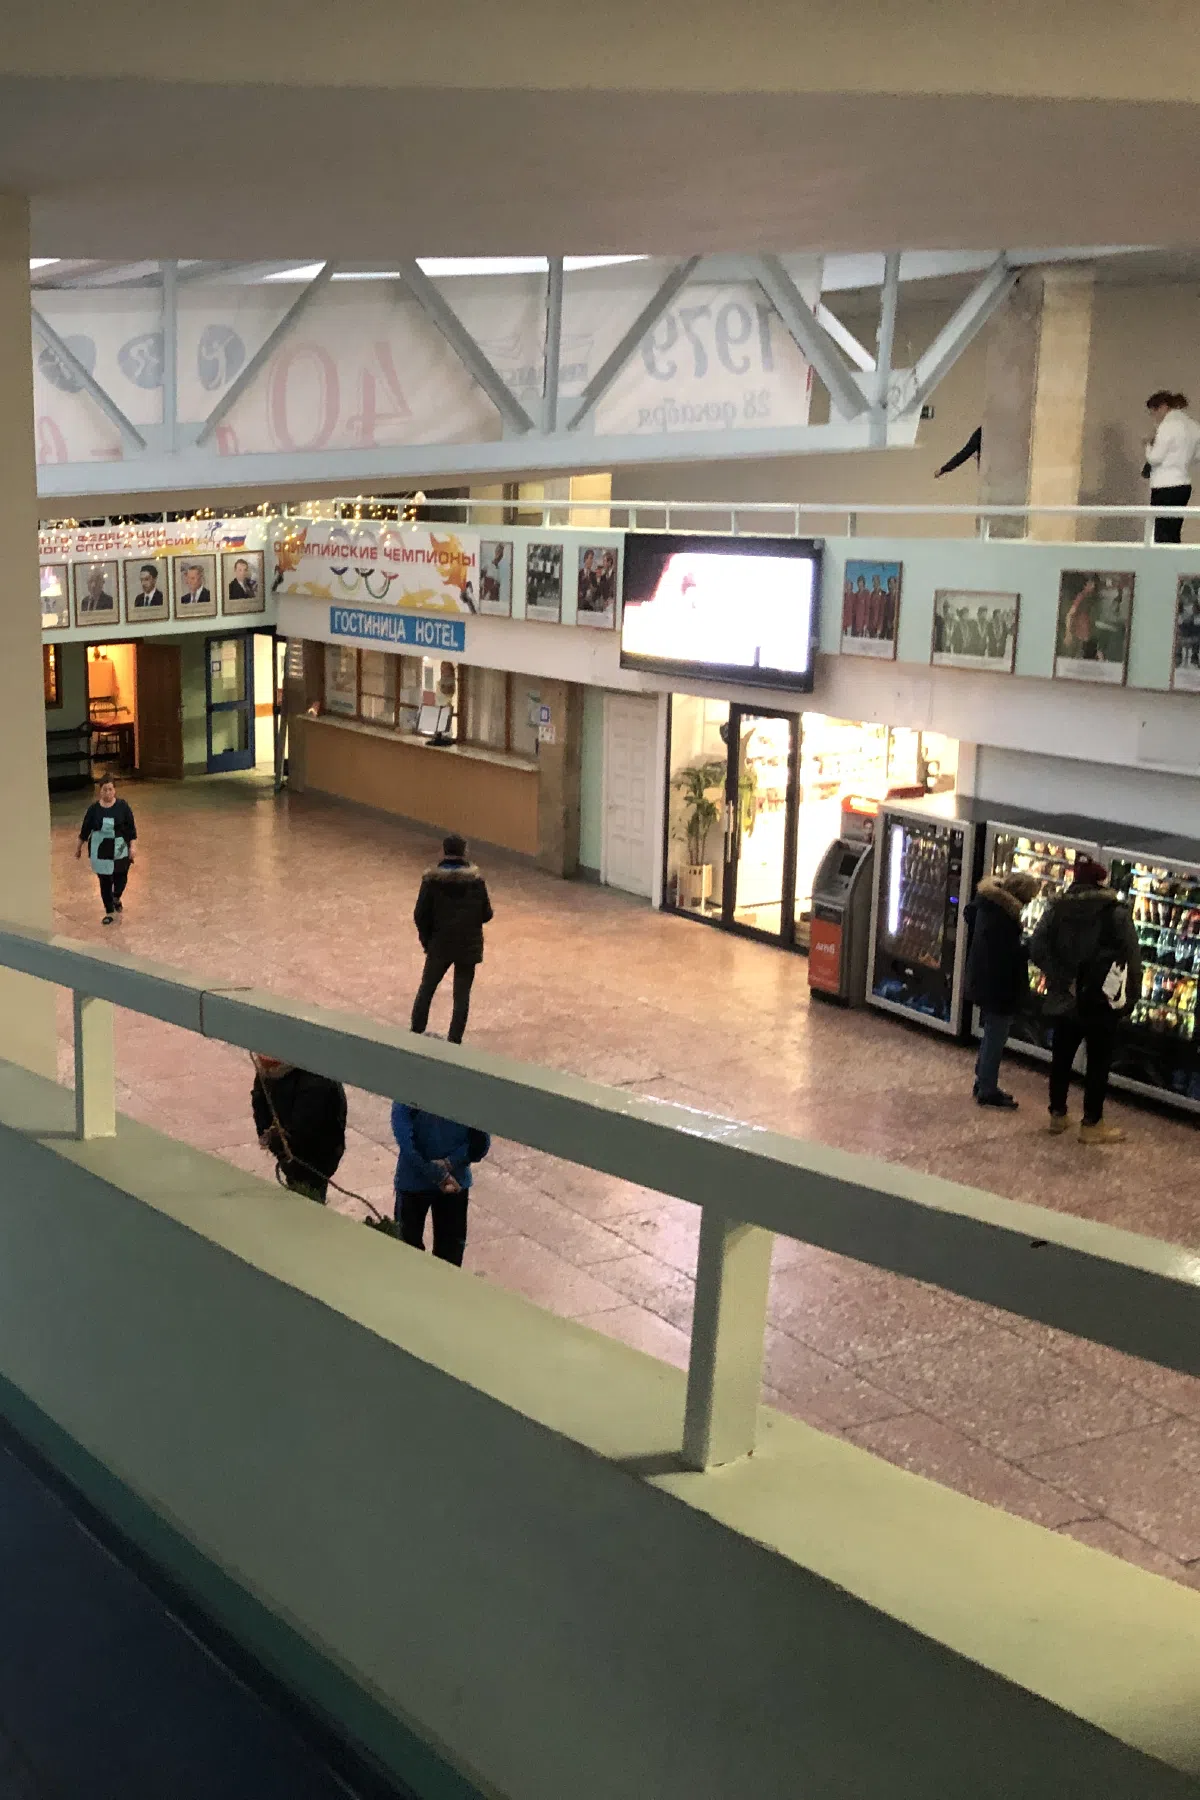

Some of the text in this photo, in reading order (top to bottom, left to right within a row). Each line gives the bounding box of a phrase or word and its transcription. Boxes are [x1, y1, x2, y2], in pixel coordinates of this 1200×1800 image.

[76, 541, 132, 553] СПОРТА
[384, 548, 476, 567] ЧЕМПИОНЫ
[333, 610, 459, 647] ГОСТИНИЦА HOTEL
